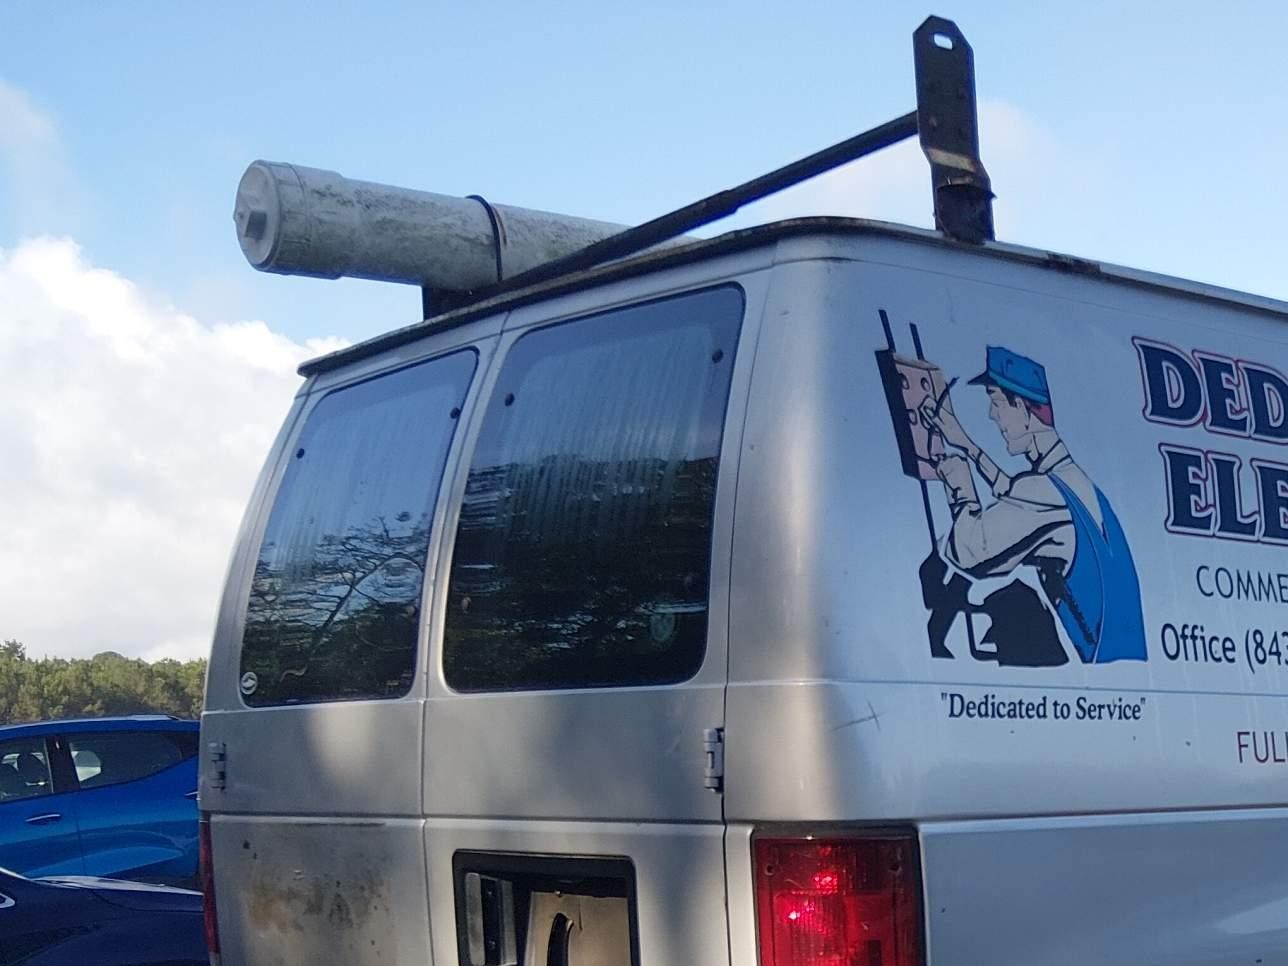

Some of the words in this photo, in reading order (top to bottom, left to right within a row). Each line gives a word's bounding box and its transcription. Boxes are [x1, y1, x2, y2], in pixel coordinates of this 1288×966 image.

[1161, 623, 1236, 663] Office
[941, 692, 1048, 719] "Dedicated
[1053, 698, 1071, 720] to
[1075, 696, 1146, 720] Service"
